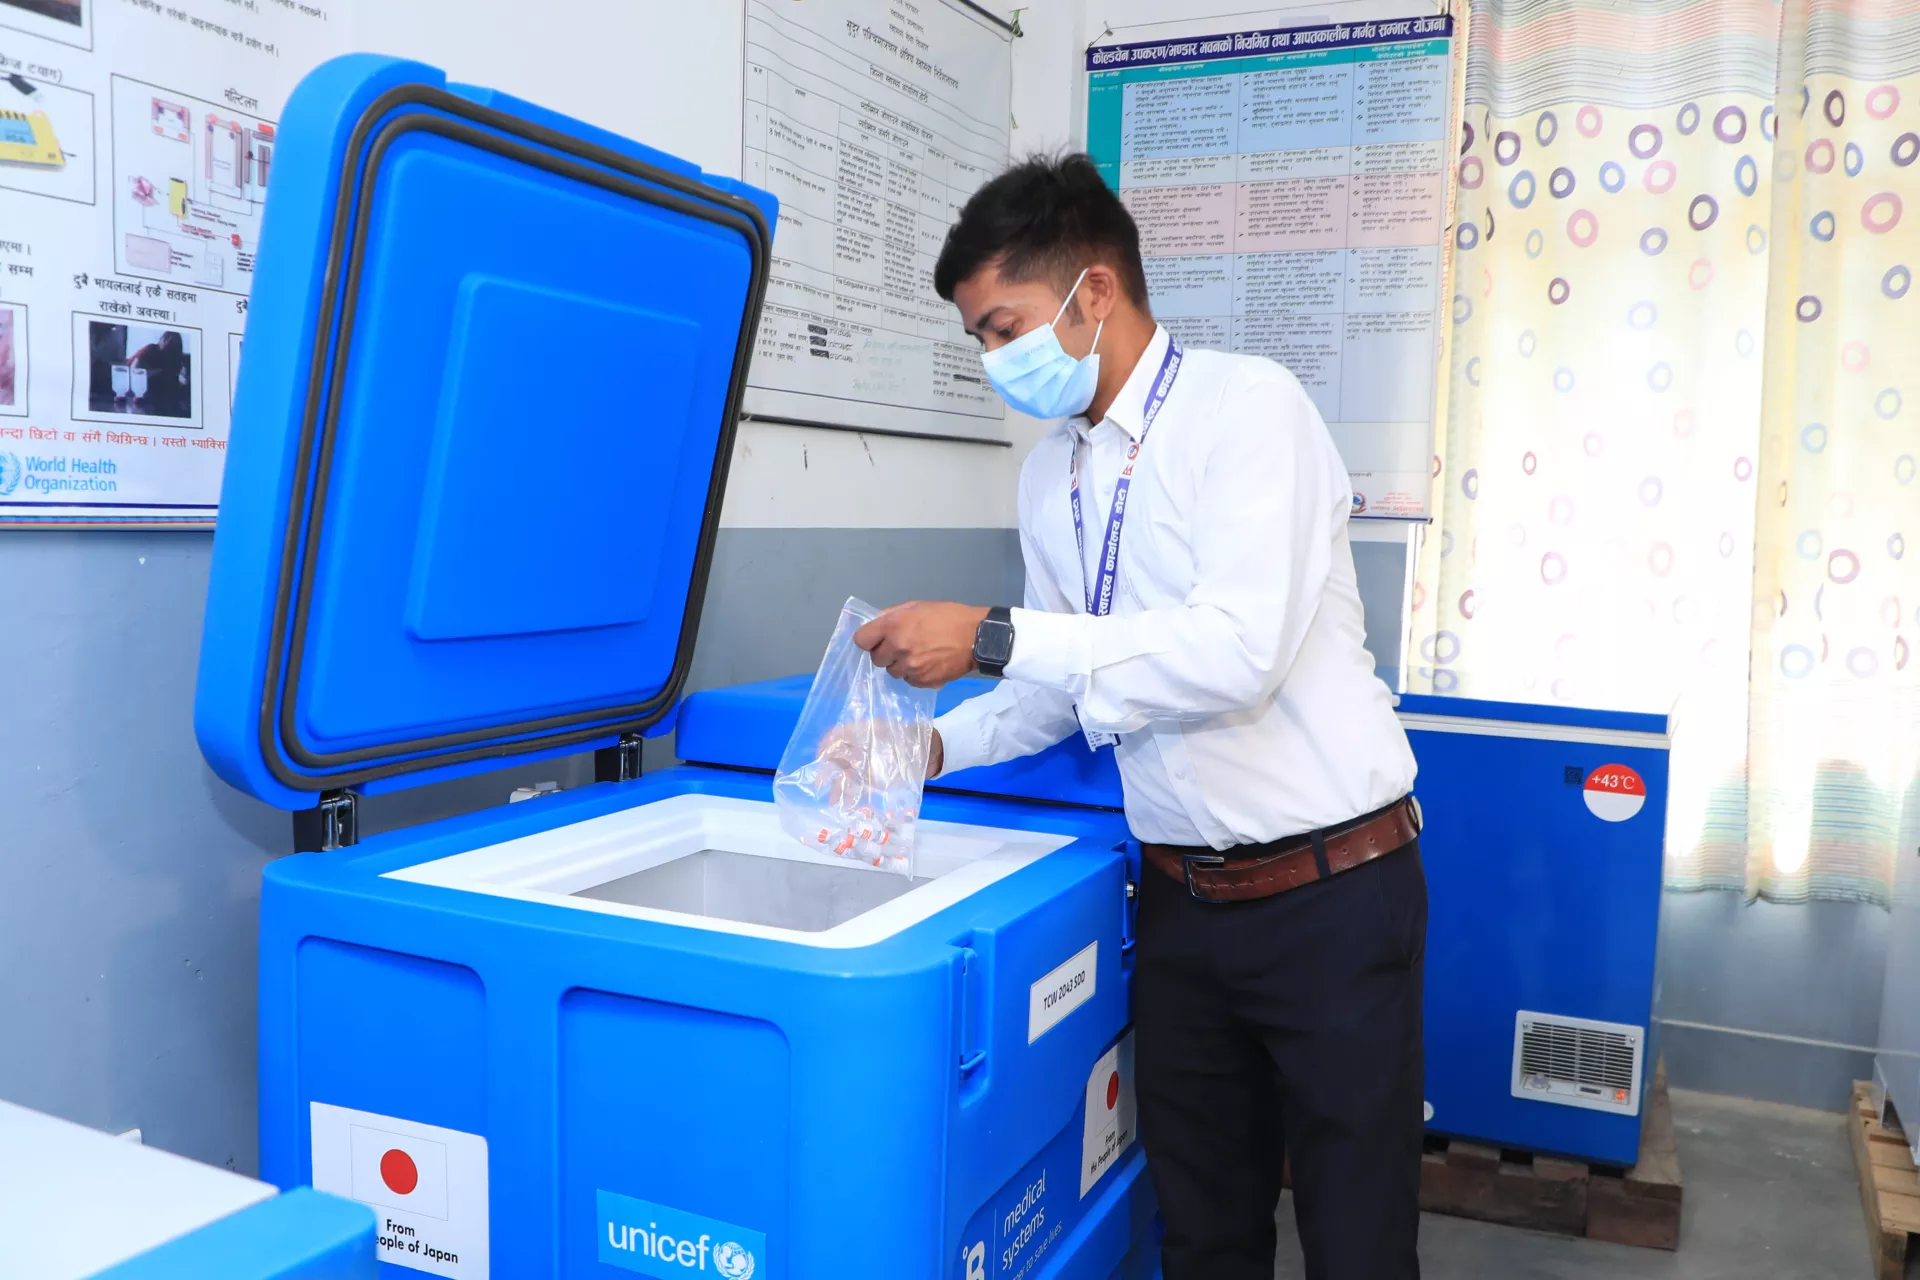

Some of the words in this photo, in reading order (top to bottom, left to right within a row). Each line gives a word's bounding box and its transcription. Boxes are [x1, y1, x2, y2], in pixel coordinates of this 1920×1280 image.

[1092, 47, 1129, 65] कोल्डचेन
[1130, 41, 1198, 61] उपकरण/भण्डार
[1200, 35, 1232, 54] भवनको
[1234, 31, 1269, 51] नियमित
[1271, 33, 1290, 49] तथा
[1292, 24, 1351, 46] आपतकालीन
[1352, 21, 1376, 39] मर्मत
[1378, 20, 1410, 37] सम्भार
[1413, 17, 1447, 33] योजना
[166, 289, 197, 303] सतहमा
[99, 300, 132, 314] राखेको
[136, 306, 169, 320] अवस्था
[29, 425, 57, 440] छिटो
[63, 432, 75, 441] वा
[162, 436, 187, 448] यस्तो
[191, 436, 227, 449] भ्याक्सि
[25, 456, 65, 472] World
[71, 458, 117, 474] Health
[24, 474, 117, 494] Organization
[1044, 990, 1058, 1011] TCW
[1059, 979, 1074, 1000] 2043
[1074, 970, 1086, 989] SDD
[1098, 1146, 1111, 1167] People
[1112, 1138, 1116, 1152] of
[1116, 1130, 1127, 1147] Japan
[1105, 1130, 1115, 1146] From
[1004, 1168, 1046, 1238] medical
[386, 1219, 415, 1237] From
[1002, 1207, 1045, 1271] systems
[375, 1234, 404, 1251] eople
[408, 1240, 420, 1254] of
[423, 1243, 458, 1264] Japan
[608, 1221, 710, 1271] unicef
